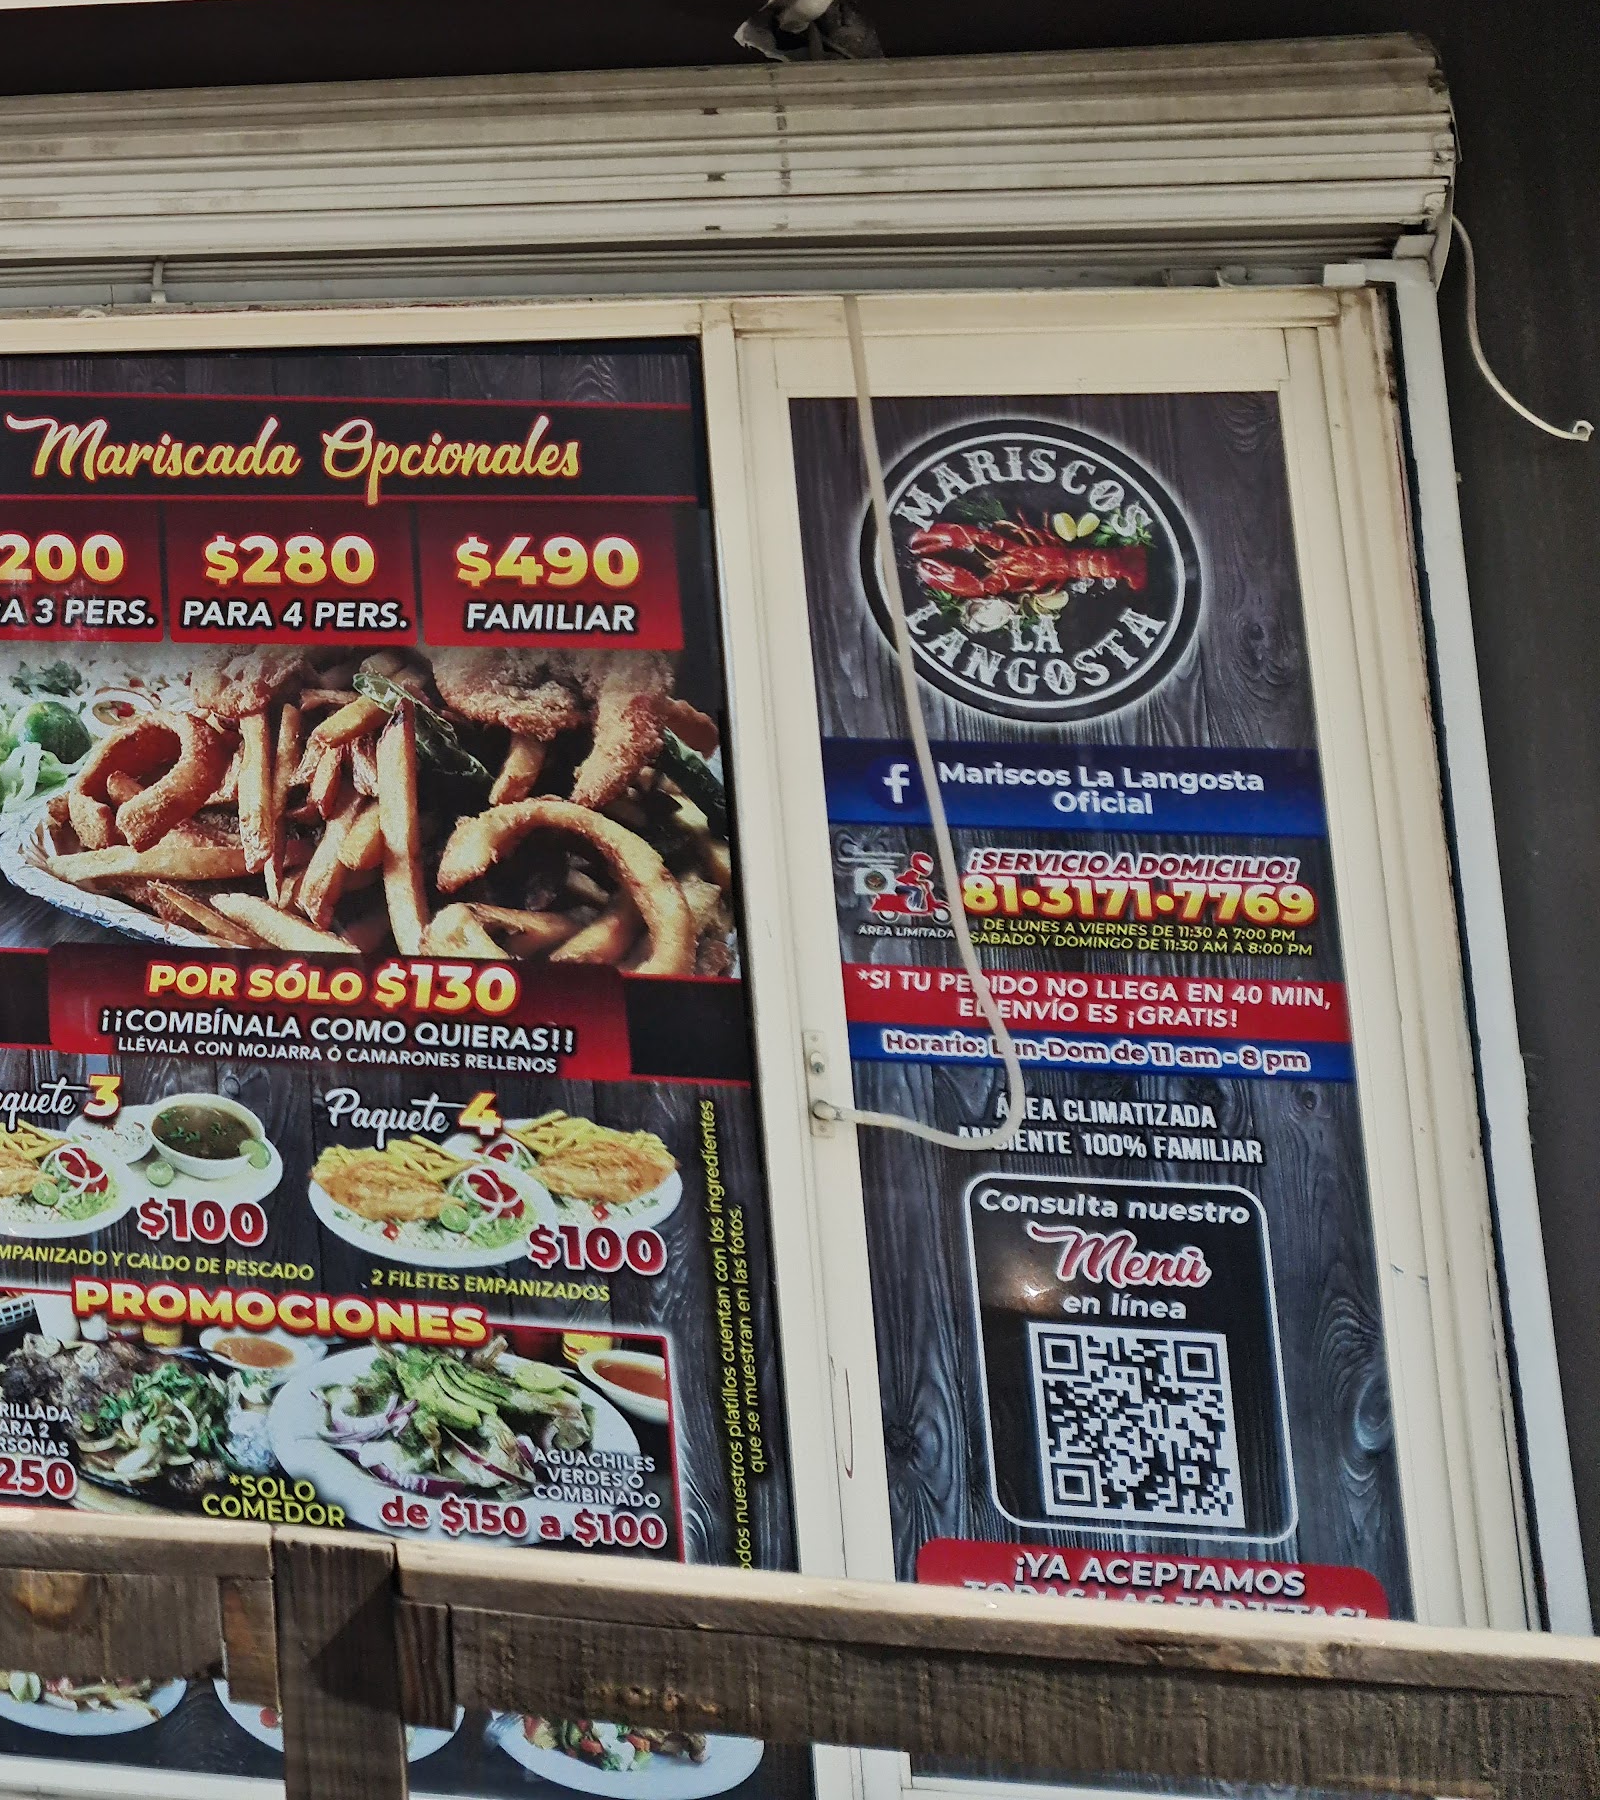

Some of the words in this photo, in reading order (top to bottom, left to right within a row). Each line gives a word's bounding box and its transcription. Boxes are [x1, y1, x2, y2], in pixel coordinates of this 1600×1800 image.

[5, 412, 300, 482] Mariscada
[320, 412, 581, 507] Opcionales
[894, 446, 1153, 537] MARISCOS
[203, 533, 376, 588] $280
[455, 535, 639, 588] $490
[34, 599, 55, 623] 3
[64, 599, 156, 626] PERS.
[184, 600, 272, 627] PARA
[282, 602, 304, 627] 4
[314, 602, 408, 630] PERS.
[467, 603, 636, 633] FAMILIAR
[905, 601, 1166, 695] LANGOSTA
[1009, 614, 1063, 653] LA
[938, 762, 1072, 787] Mariscos
[1079, 766, 1115, 788] La
[1123, 767, 1264, 794] Langosta
[1053, 790, 1154, 815] Oficial
[970, 850, 1110, 875] ¡SERVICIO
[1139, 857, 1299, 881] DOMICILIO!
[984, 919, 1004, 930] DE
[1010, 920, 1060, 933] LUNES
[1080, 922, 1147, 937] VIERNES
[1152, 925, 1173, 937] DE
[1179, 926, 1212, 939] 11:30
[1234, 928, 1266, 941] 7:00
[1272, 930, 1295, 941] PM
[149, 964, 243, 996] POR
[247, 962, 363, 1005] SÓLO
[375, 960, 517, 1013] $130
[900, 970, 931, 992] TU
[940, 973, 1038, 996] PEIDO
[1047, 978, 1088, 998] NO
[1096, 980, 1178, 1002] LLEGA
[1188, 983, 1223, 1003] EN
[1232, 986, 1262, 1005] 40
[1271, 987, 1330, 1010] MIN,
[101, 1004, 303, 1040] ¡¡COMBÍNALA
[311, 1017, 405, 1045] COMO
[414, 1023, 574, 1053] QUIERAS!!
[998, 998, 1079, 1022] ENVÍO
[1088, 1004, 1118, 1024] ES
[1128, 1006, 1238, 1028] ¡GRATIS!
[118, 1033, 189, 1055] LLÉVALA
[195, 1039, 234, 1057] CON
[239, 1040, 324, 1062] MOJARRA
[346, 1046, 460, 1069] CAMARONES
[465, 1052, 558, 1074] RELLENOS
[885, 1032, 985, 1055] Horario:
[1115, 1043, 1145, 1061] de
[1151, 1046, 1171, 1062] 11
[1179, 1051, 1219, 1065] am
[1242, 1049, 1258, 1066] 8
[1266, 1052, 1307, 1071] pm
[83, 1073, 121, 1118] 3
[1063, 1100, 1218, 1129] CLIMATIZADA
[325, 1088, 468, 1150] Paquete
[457, 1091, 503, 1136] 4
[1082, 1133, 1147, 1159] 100%
[1154, 1137, 1263, 1164] FAMILIAR
[138, 1197, 268, 1247] $100
[980, 1188, 1120, 1220] Consulta
[1127, 1199, 1251, 1226] nuestro
[527, 1224, 668, 1276] $100
[1026, 1220, 1213, 1288] Menú
[371, 1269, 383, 1286] 2
[387, 1270, 459, 1292] FILETES
[464, 1276, 610, 1302] EMPANIZADOS
[72, 1275, 490, 1348] PROMOCIONES
[1063, 1297, 1103, 1316] en
[1111, 1294, 1188, 1321] línea
[38, 1421, 51, 1439] 2
[533, 1449, 655, 1472] AGUACHILES
[547, 1467, 624, 1485] VERDES
[202, 1492, 346, 1528] COMEDOR
[533, 1484, 661, 1509] COMBINADO
[381, 1496, 429, 1528] de
[439, 1495, 528, 1537] $150
[539, 1512, 562, 1536] a
[572, 1508, 667, 1550] $100
[1015, 1552, 1070, 1583] ¡YA
[1079, 1557, 1306, 1598] ACEPTAMOS
